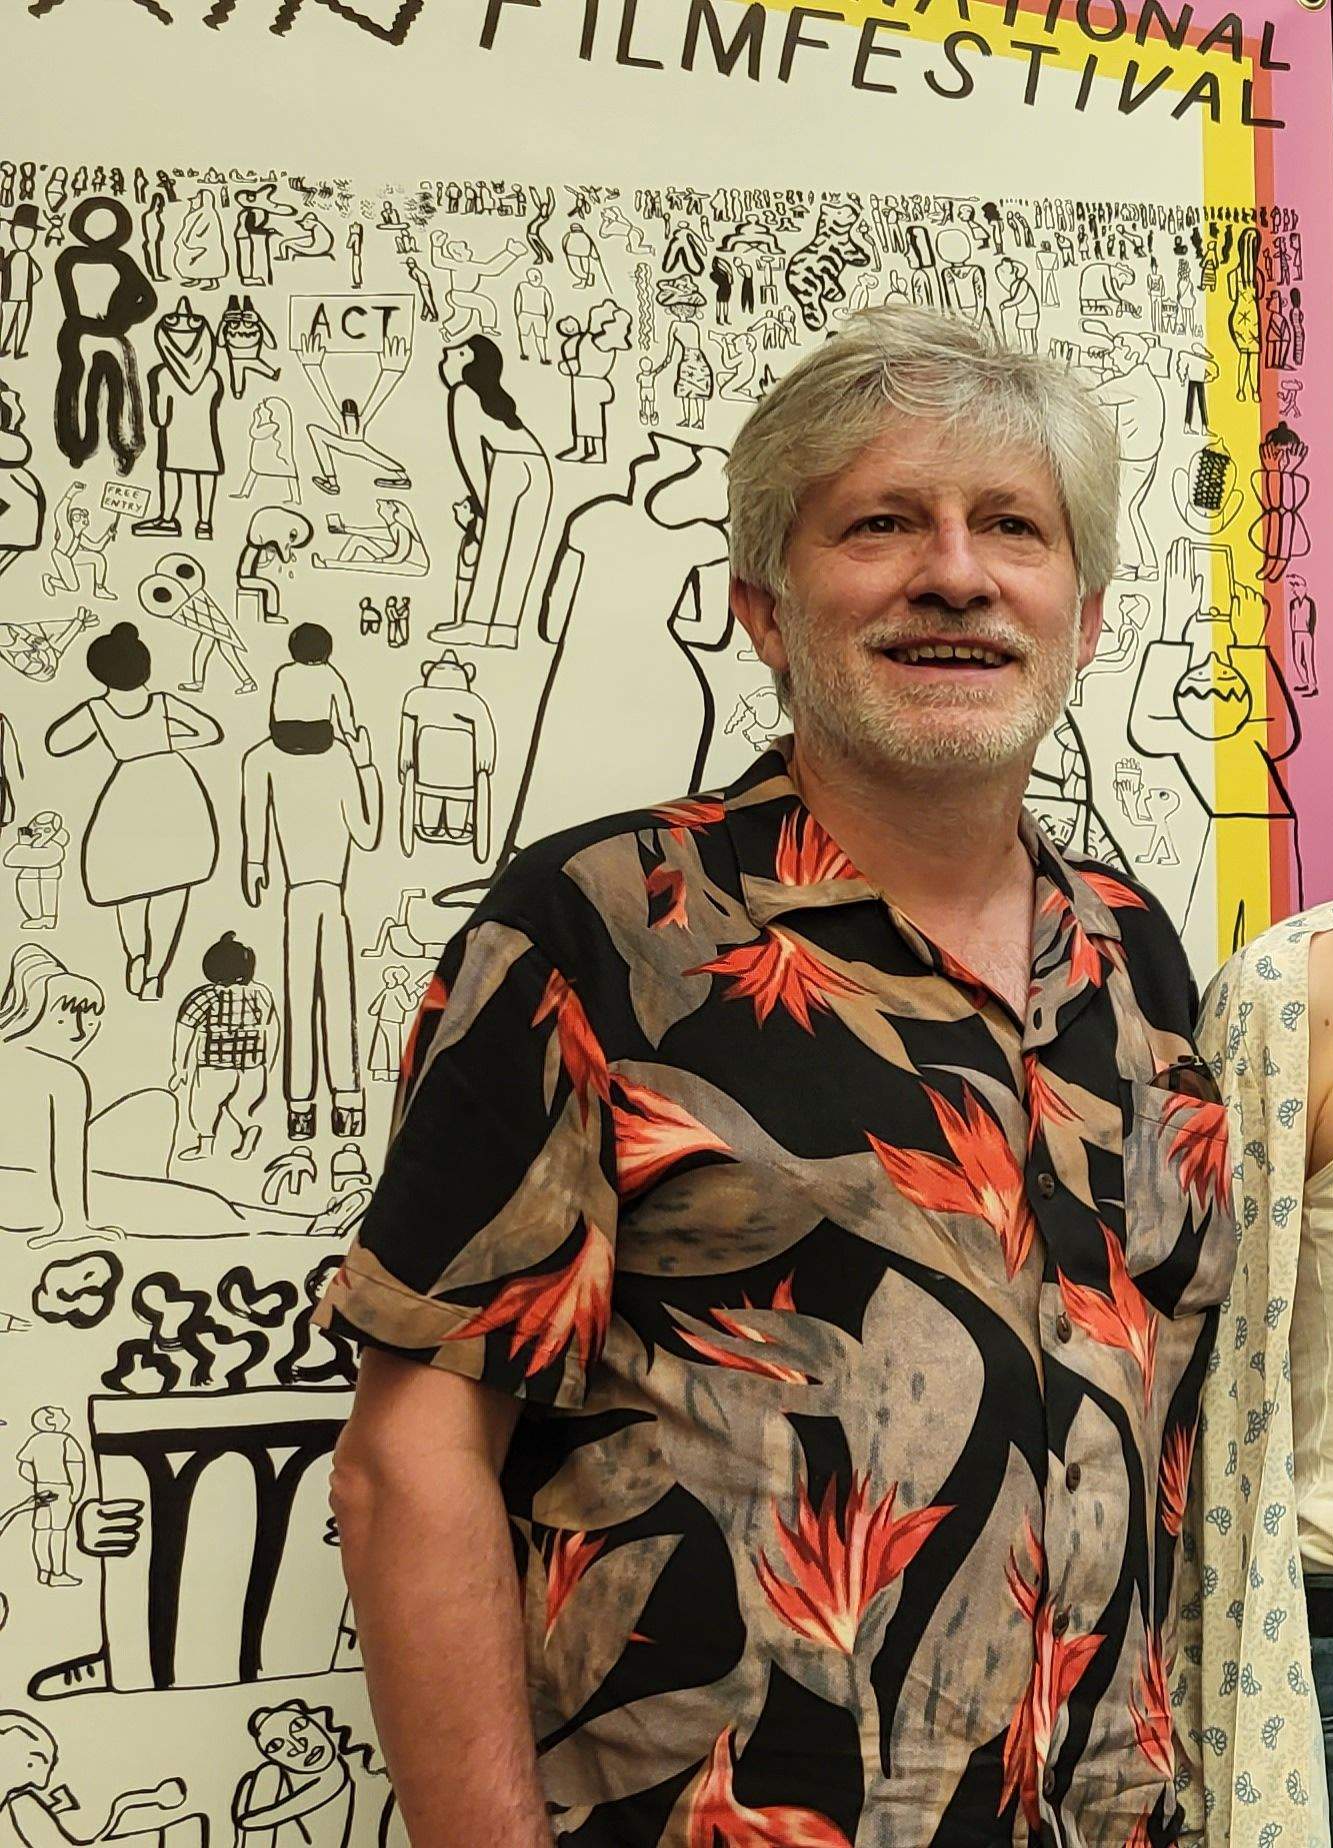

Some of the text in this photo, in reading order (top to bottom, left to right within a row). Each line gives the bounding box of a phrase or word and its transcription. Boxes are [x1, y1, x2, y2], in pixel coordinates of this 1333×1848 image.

[311, 302, 400, 340] ACT
[108, 486, 140, 499] FREE
[105, 497, 142, 512] ENTRY
